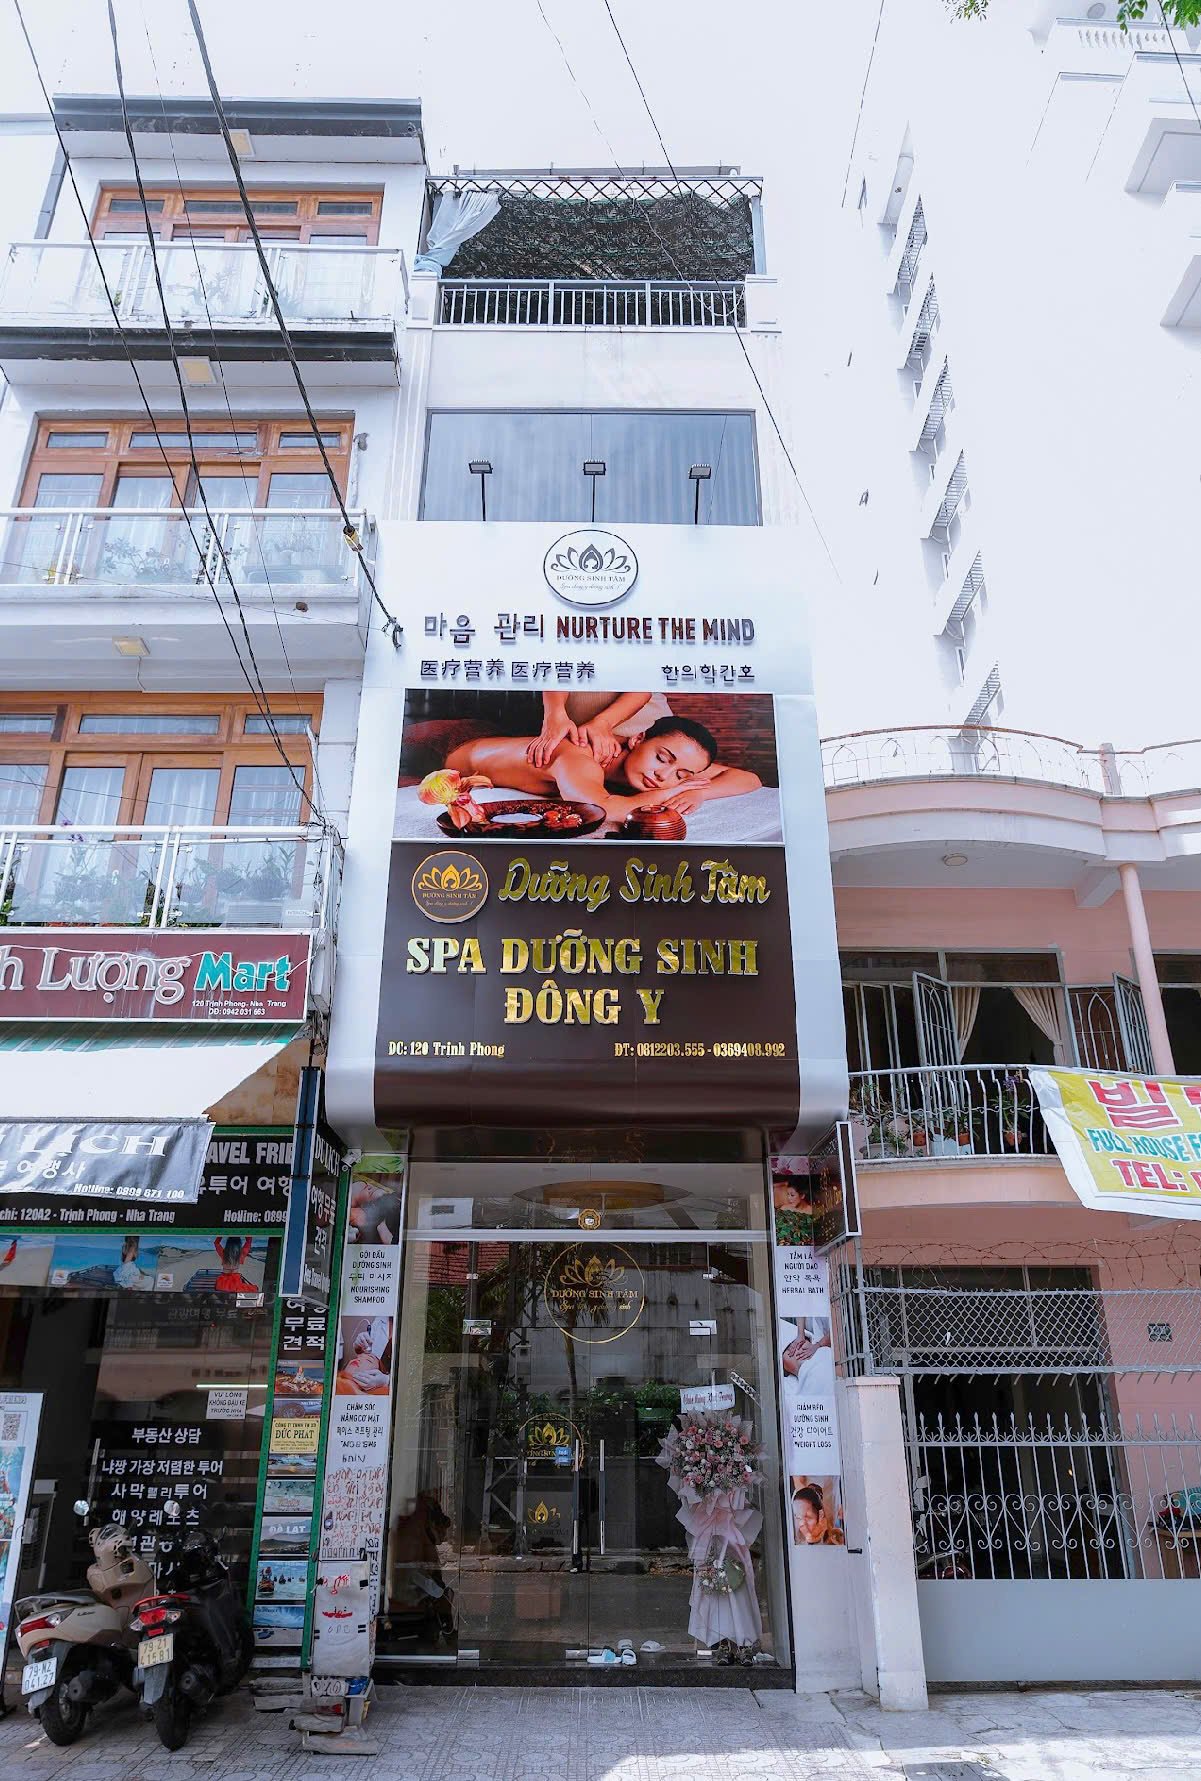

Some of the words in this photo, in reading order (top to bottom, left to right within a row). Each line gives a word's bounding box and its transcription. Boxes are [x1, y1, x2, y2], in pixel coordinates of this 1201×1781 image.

[424, 612, 476, 645] 마음
[493, 612, 545, 641] 관리
[556, 615, 653, 641] NURTURE
[657, 617, 696, 641] THE
[702, 618, 755, 641] MIND
[420, 658, 504, 678] 医疗营养
[511, 660, 595, 680] 医疗营养
[661, 664, 755, 684] 한의학간호
[498, 857, 611, 913] Dưỡng
[619, 857, 696, 903] Sinh
[700, 859, 771, 904] Tâm
[406, 937, 487, 975] SPA
[499, 928, 643, 975] DƯỠNG
[656, 938, 760, 976] SINH
[36, 947, 192, 1005] Lượng
[193, 950, 291, 992] Mart
[267, 1000, 287, 1008] Trang
[503, 979, 622, 1025] ĐÔNG
[636, 988, 665, 1025] Y
[410, 1041, 429, 1056] 120
[432, 1041, 465, 1059] Trịnh
[470, 1041, 505, 1058] Phong
[1086, 1128, 1133, 1155] FULL
[1131, 1134, 1190, 1162] HOUSE
[1112, 1159, 1188, 1191] TEL:
[73, 1183, 114, 1195] Hotline:
[20, 1208, 52, 1221] 120A2
[59, 1208, 84, 1223] Trịnh
[86, 1208, 118, 1223] Phong
[126, 1208, 146, 1222] Nha
[148, 1208, 176, 1223] Trang
[223, 1209, 262, 1223] Hotline:
[588, 1289, 614, 1298] SINH
[283, 1316, 326, 1332] 무료
[283, 1335, 325, 1351] 견적
[131, 1427, 173, 1444] 부동산
[174, 1427, 202, 1444] 상담
[128, 1459, 156, 1476] 가장
[156, 1459, 195, 1476] 저렴한
[197, 1460, 224, 1476] 투어
[24, 1672, 55, 1690] 041.27
